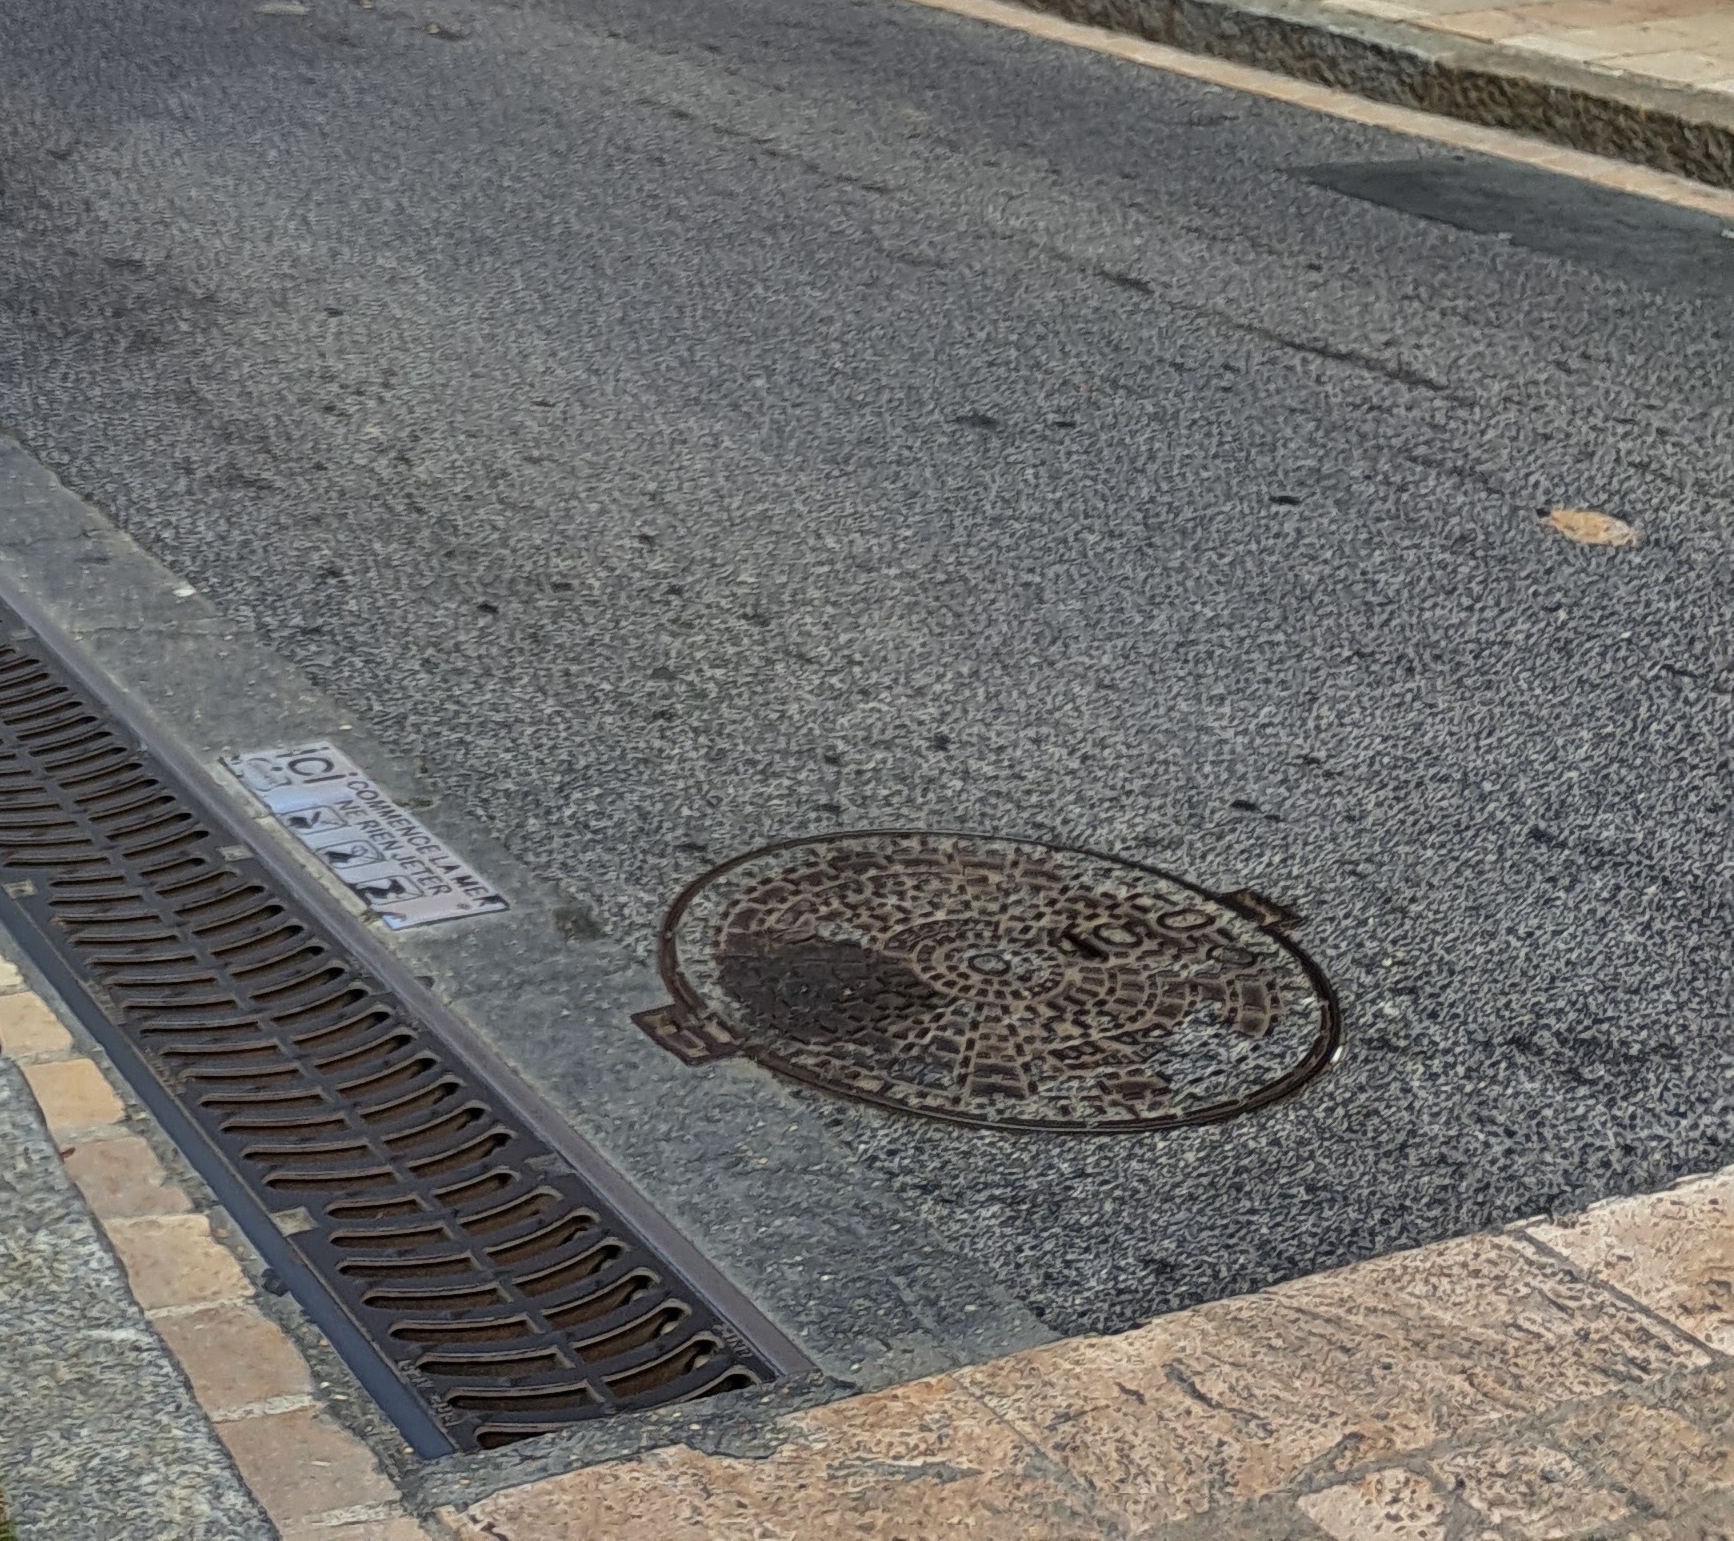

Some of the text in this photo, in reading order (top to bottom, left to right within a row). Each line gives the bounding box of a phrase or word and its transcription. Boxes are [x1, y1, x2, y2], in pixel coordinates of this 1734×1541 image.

[335, 798, 453, 896] NE RIEN JETER
[346, 779, 442, 855] COMMENCE
[428, 855, 462, 875] LA
